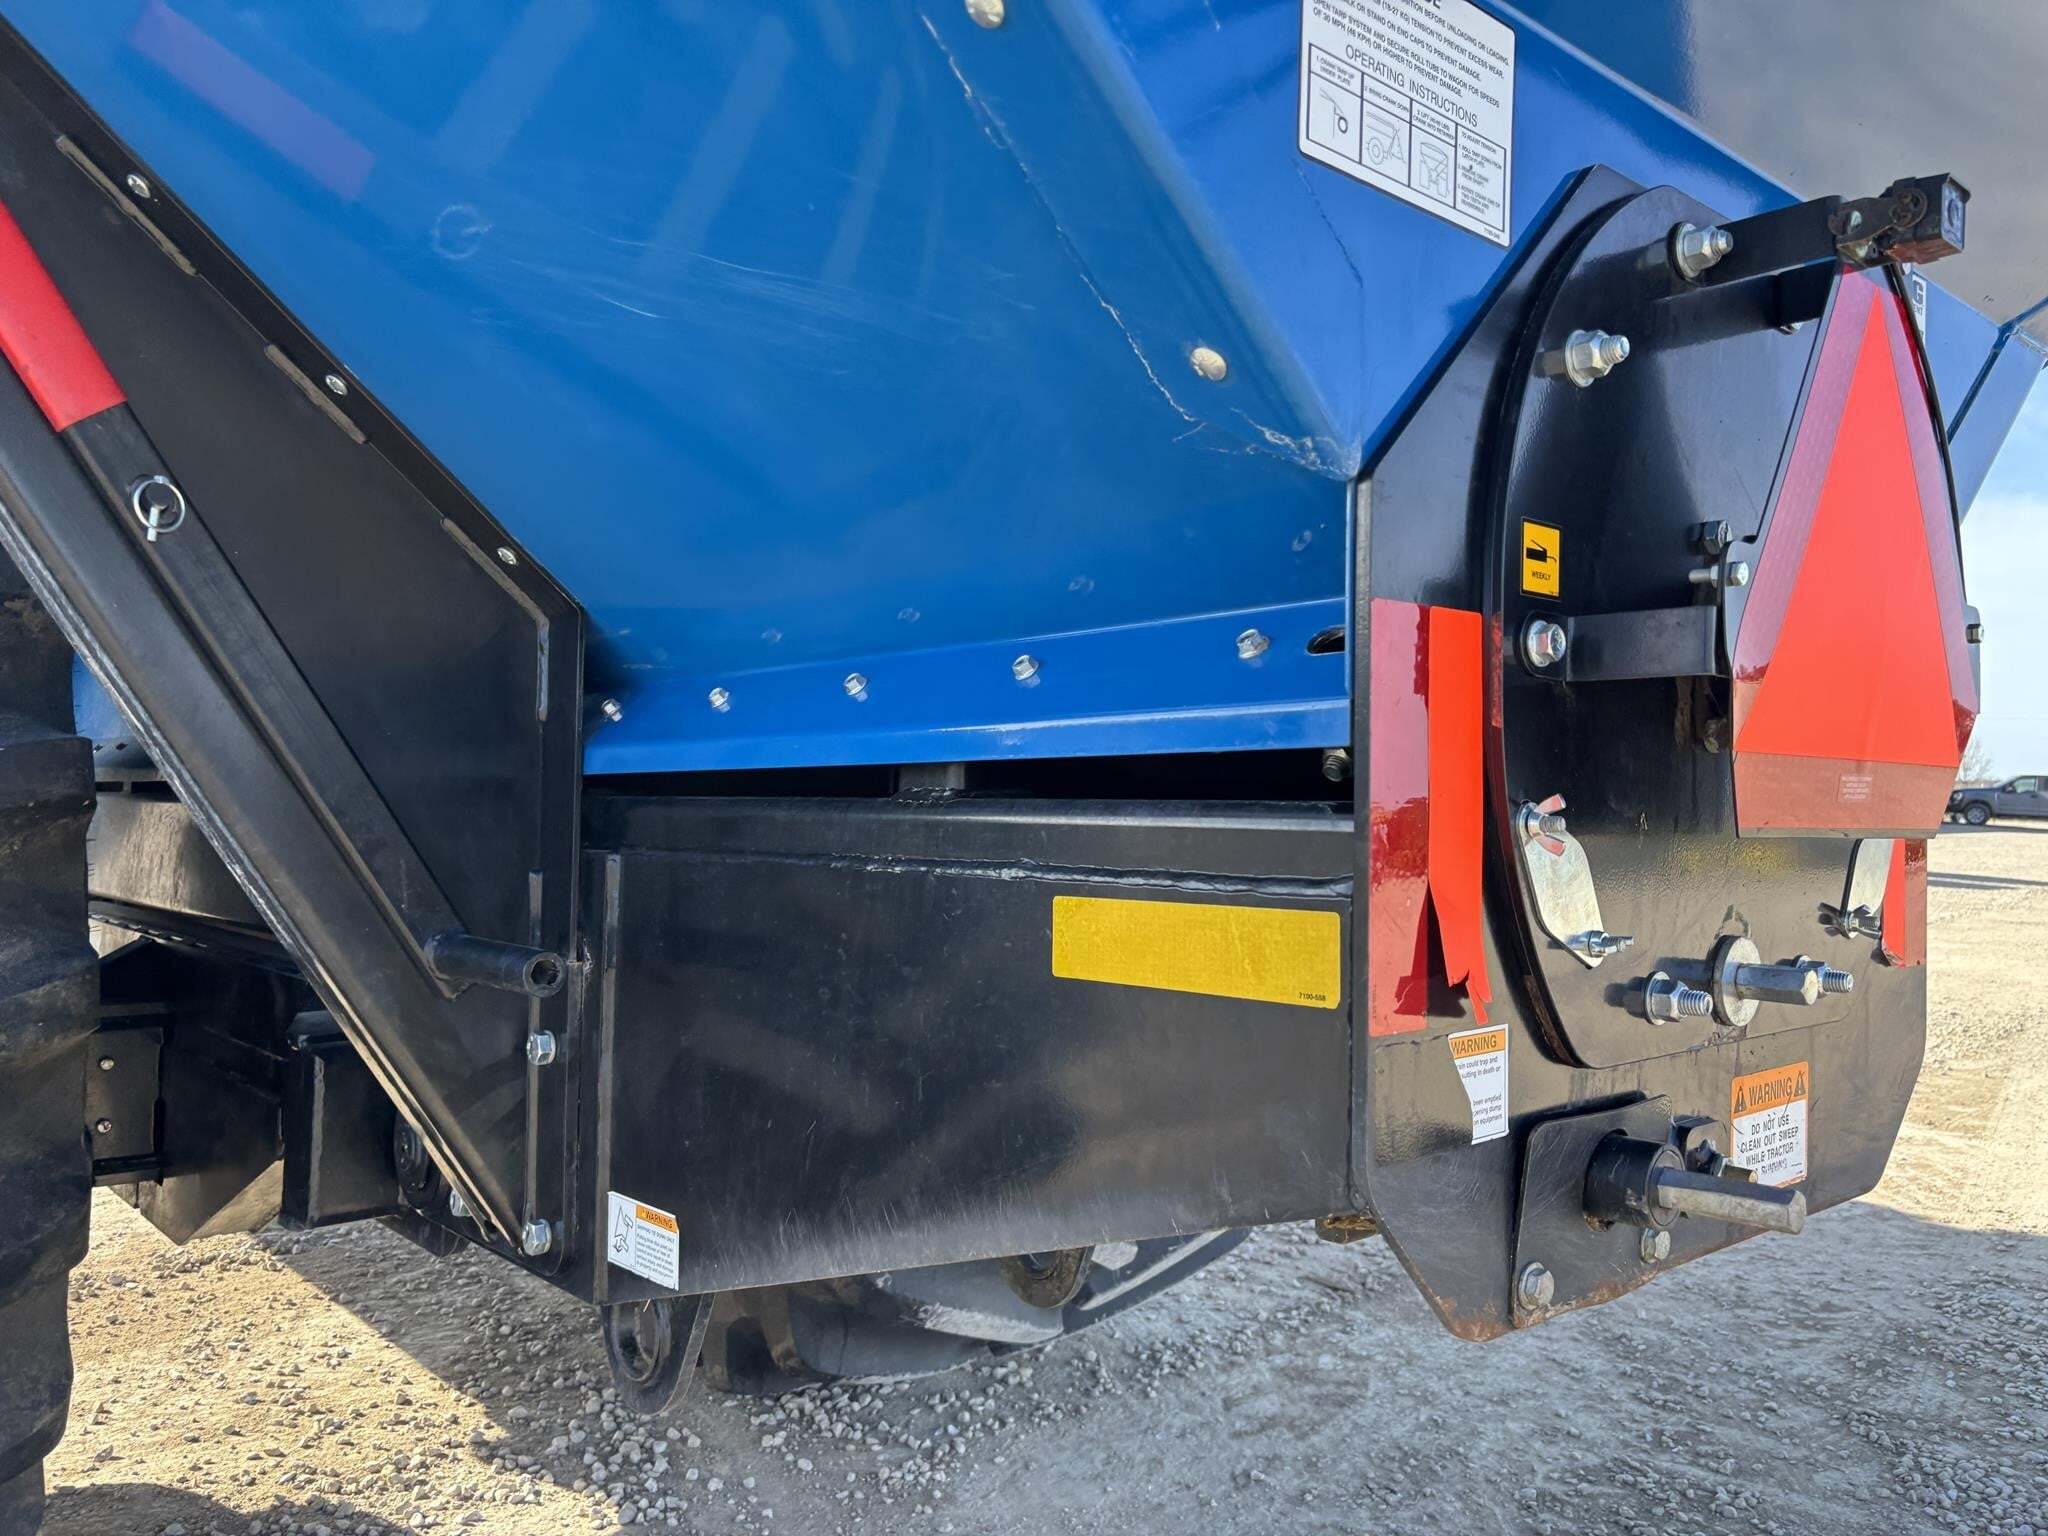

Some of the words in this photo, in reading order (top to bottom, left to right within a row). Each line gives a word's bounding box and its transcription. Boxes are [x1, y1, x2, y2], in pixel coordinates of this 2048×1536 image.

[1313, 5, 1321, 18] OF
[1331, 16, 1345, 32] MPH
[1356, 30, 1371, 46] KPH)
[1372, 39, 1381, 52] OR
[1382, 44, 1404, 65] HIGHER
[1405, 57, 1412, 69] TO
[1414, 62, 1438, 83] PREVENT
[1356, 2, 1365, 14] OR
[1367, 8, 1385, 26] STAND
[1386, 20, 1395, 32] ON
[1397, 26, 1408, 40] END
[1409, 33, 1424, 49] CAPS
[1425, 42, 1432, 53] TO
[1433, 47, 1456, 68] PREVENT
[1399, 10, 1410, 24] KG)
[1411, 17, 1434, 38] TENSION
[1435, 31, 1442, 43] TO
[1443, 36, 1467, 57] PREVENT
[1468, 51, 1487, 70] EXCESS
[1424, 8, 1445, 28] BEFORE
[1446, 22, 1477, 47] UNLOADING
[1477, 40, 1485, 52] OR
[1331, 5, 1346, 21] TARP
[1348, 14, 1372, 36] SYSTEM
[1372, 28, 1385, 43] AND
[1386, 36, 1409, 57] SECURE
[1410, 50, 1424, 66] ROLL
[1425, 59, 1439, 74] TUBE
[1440, 67, 1447, 79] TO
[1448, 72, 1467, 90] WAGON
[1468, 83, 1478, 96] FOR
[1480, 90, 1499, 108] SPEEDS
[1345, 42, 1404, 89] OPERATING
[1409, 77, 1477, 128] INSTRUCTIONS
[1531, 570, 1551, 581] WEEKLY
[1451, 1035, 1497, 1055] WARNING
[1749, 1077, 1793, 1106] WARNING
[1740, 1138, 1761, 1153] CLEAN
[1764, 1133, 1776, 1146] OUT
[1779, 1126, 1799, 1142] SWEEP
[1751, 1123, 1761, 1136] DO
[1763, 1118, 1775, 1132] NOT
[1778, 1114, 1789, 1127] USE
[1745, 1151, 1765, 1166] WHILE
[1767, 1142, 1794, 1158] TRACTOR
[646, 1210, 673, 1229] WARNING
